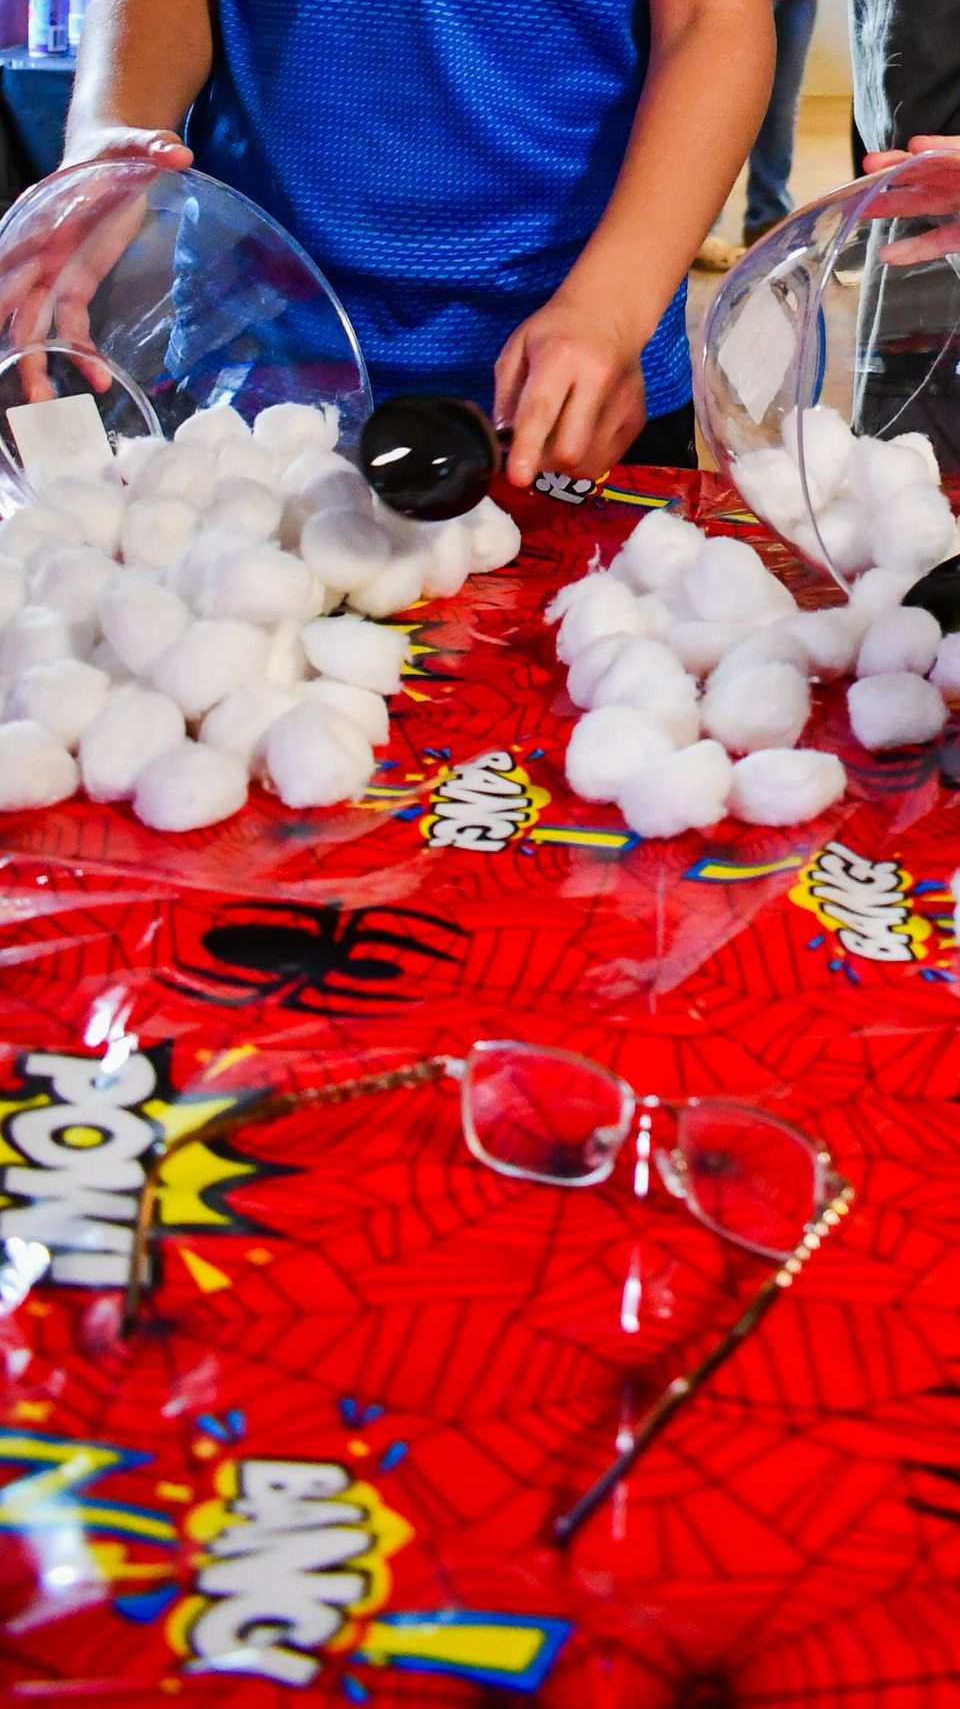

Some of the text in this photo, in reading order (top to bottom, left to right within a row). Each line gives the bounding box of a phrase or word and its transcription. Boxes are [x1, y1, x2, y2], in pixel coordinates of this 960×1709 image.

[428, 750, 530, 852] BANG!
[811, 840, 914, 963] BANG!
[182, 1458, 374, 1688] BANG!
